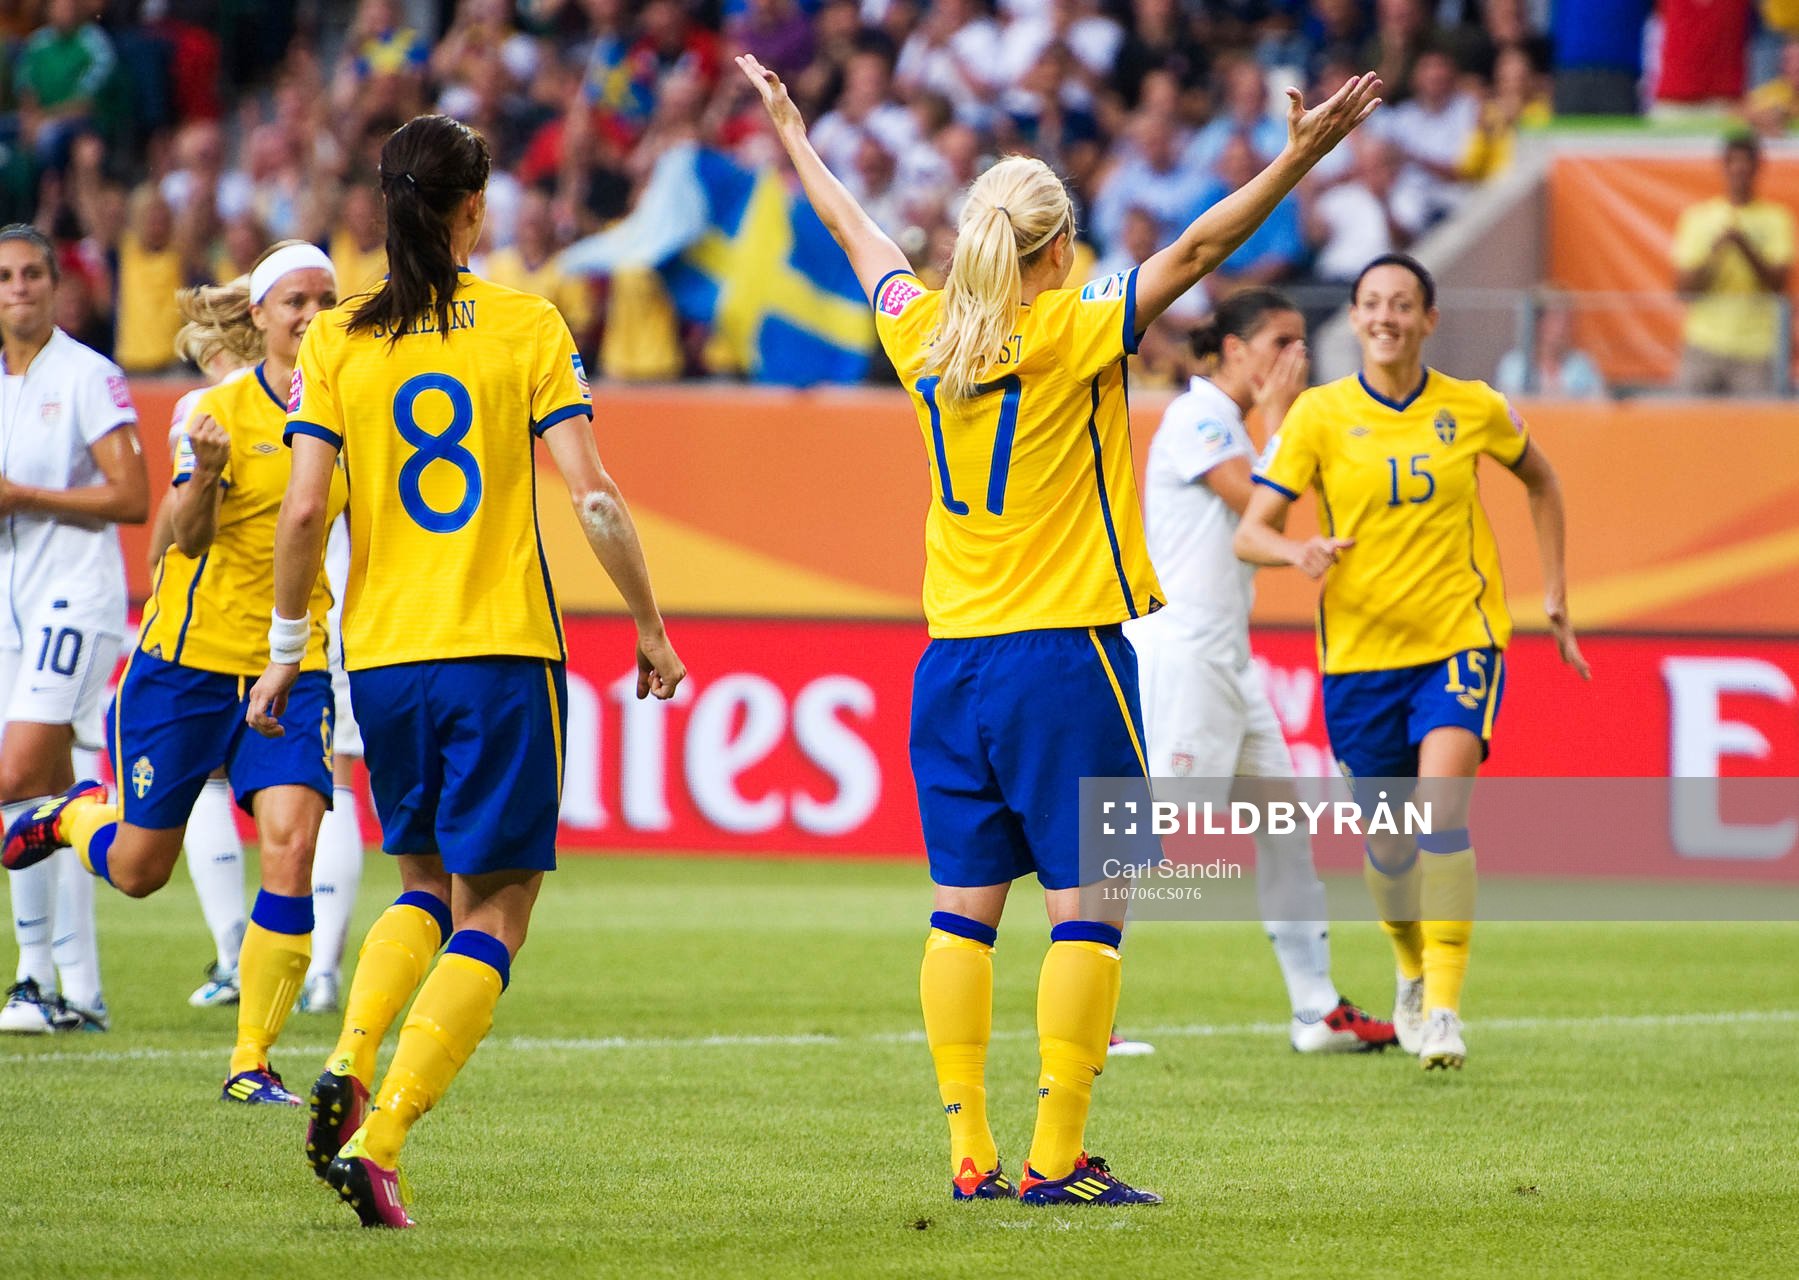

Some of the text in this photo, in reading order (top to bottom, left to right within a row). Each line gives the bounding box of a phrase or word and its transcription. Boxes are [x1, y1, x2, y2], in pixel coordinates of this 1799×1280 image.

[393, 372, 483, 534] 8
[914, 373, 1021, 517] 17
[1386, 454, 1436, 508] 15
[37, 626, 83, 676] 10
[1445, 650, 1487, 697] 15
